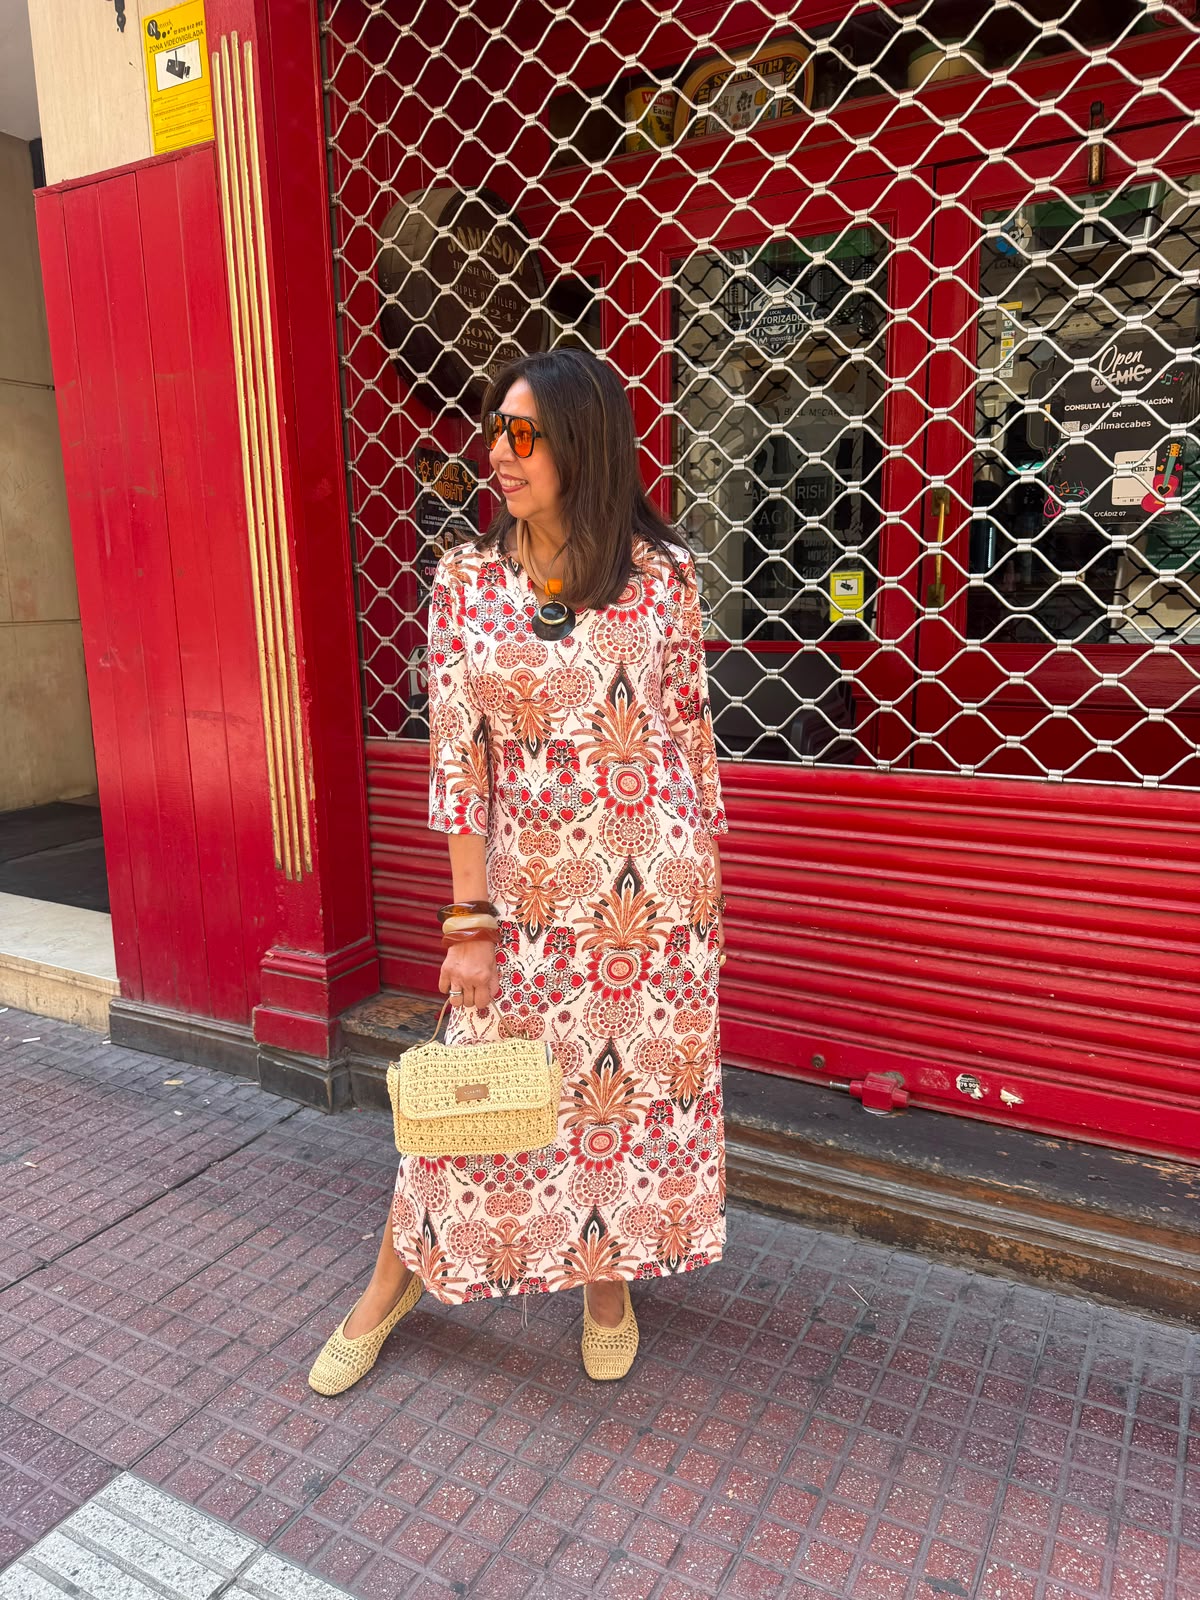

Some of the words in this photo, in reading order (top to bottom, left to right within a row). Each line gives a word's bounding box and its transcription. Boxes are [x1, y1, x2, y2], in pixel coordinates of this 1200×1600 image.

[149, 43, 163, 53] ZONA
[164, 28, 204, 47] VIDEOVIGILADA
[447, 226, 525, 276] JAMESON
[451, 283, 477, 298] RIPLE
[480, 290, 517, 310] DITILLED
[1099, 344, 1143, 373] Open
[1064, 403, 1100, 412] CONSULTA
[1101, 402, 1111, 410] LA
[433, 460, 460, 482] QUIZ
[796, 483, 828, 499] RISH
